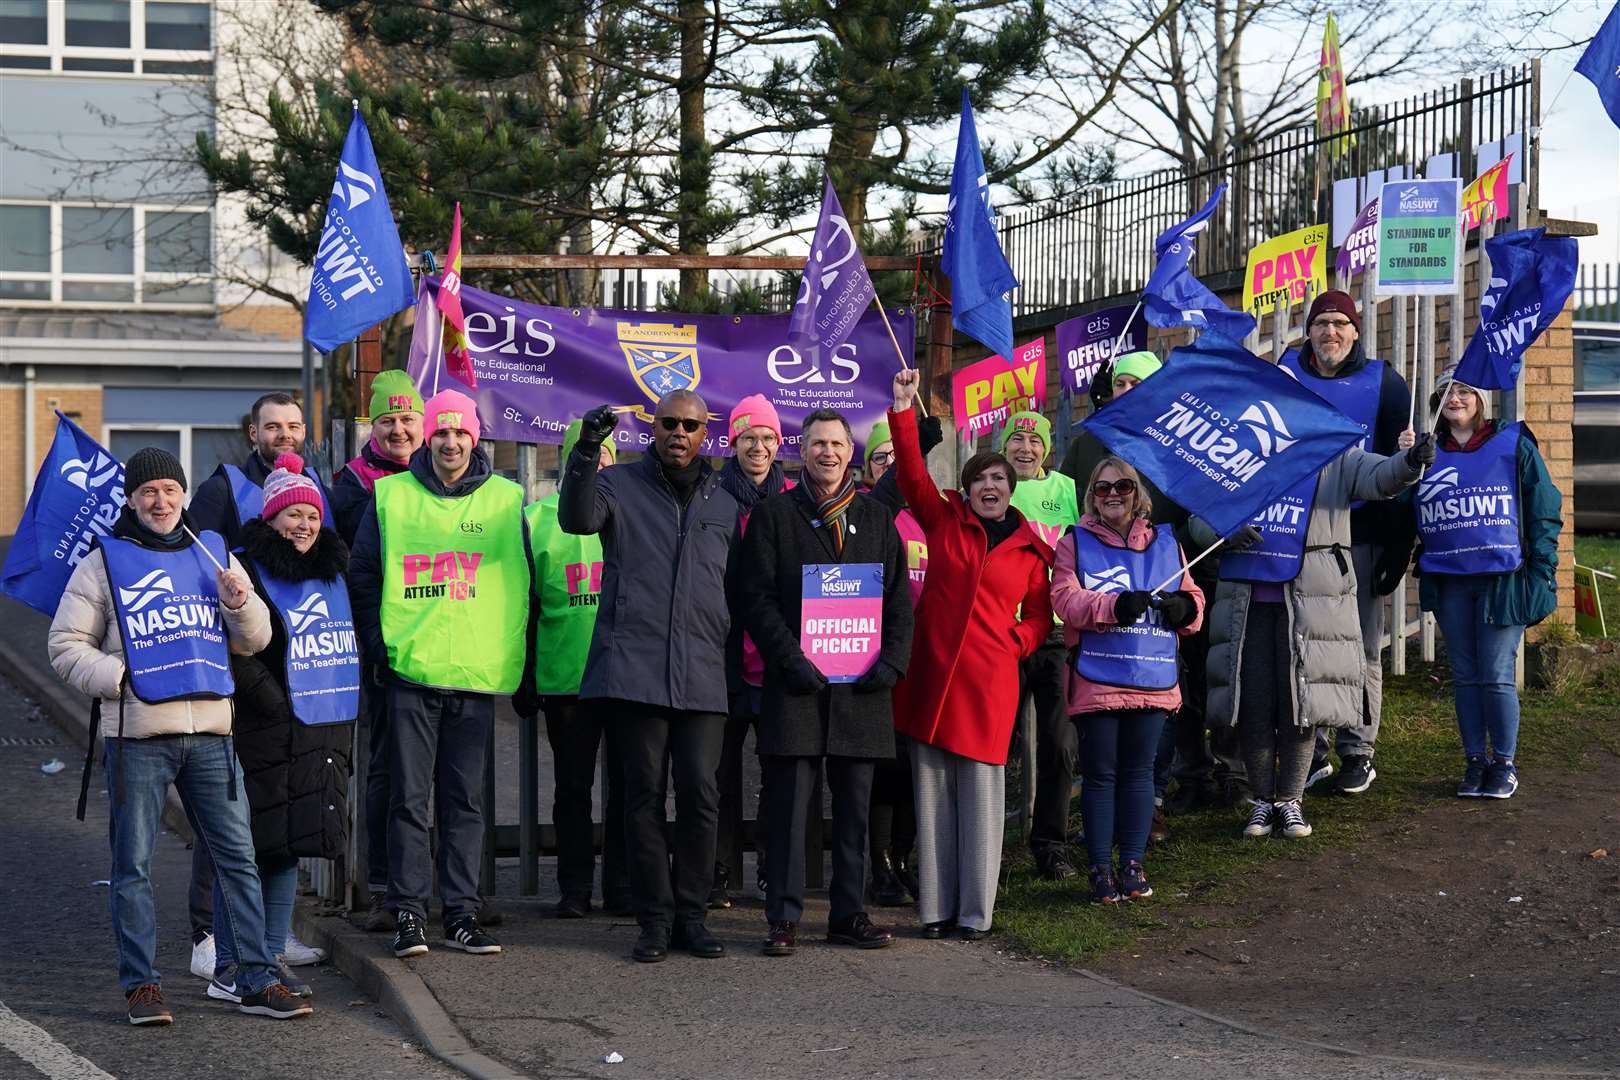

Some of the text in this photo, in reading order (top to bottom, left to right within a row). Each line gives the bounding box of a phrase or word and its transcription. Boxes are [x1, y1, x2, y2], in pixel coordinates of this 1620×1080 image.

[1400, 200, 1439, 210] NASUWT
[1303, 230, 1324, 245] eis
[1387, 227, 1451, 239] STANDING UP
[330, 208, 384, 287] SCOTLAND
[1409, 243, 1428, 253] FOR
[1253, 244, 1318, 295] PAY
[1389, 257, 1447, 268] STANDARDS
[312, 272, 338, 310] Union
[464, 306, 556, 357] eis
[1087, 316, 1110, 334] eis
[767, 334, 860, 384] eis
[1023, 344, 1042, 362] eis
[1067, 332, 1136, 370] OFFICIAL
[488, 360, 546, 372] Educational
[500, 372, 510, 381] of
[511, 373, 554, 386] Scotland
[778, 388, 854, 398] The Educational
[965, 360, 1038, 417] PAY
[773, 398, 863, 409] Institute of Scotland
[503, 407, 524, 424] St.
[1448, 486, 1509, 496] SCOTLAND
[1041, 499, 1062, 512] eis
[1420, 494, 1513, 525] NASUWT
[461, 520, 483, 534] eis
[1269, 524, 1297, 535] Union
[1422, 517, 1511, 535] The Teachers' Union
[403, 551, 484, 585] PAY
[822, 582, 861, 593] NASUWT
[805, 618, 877, 635] OFFICIAL
[132, 640, 153, 650] The
[203, 630, 222, 643] Union
[812, 637, 870, 654] PICKET
[292, 662, 309, 671] The
